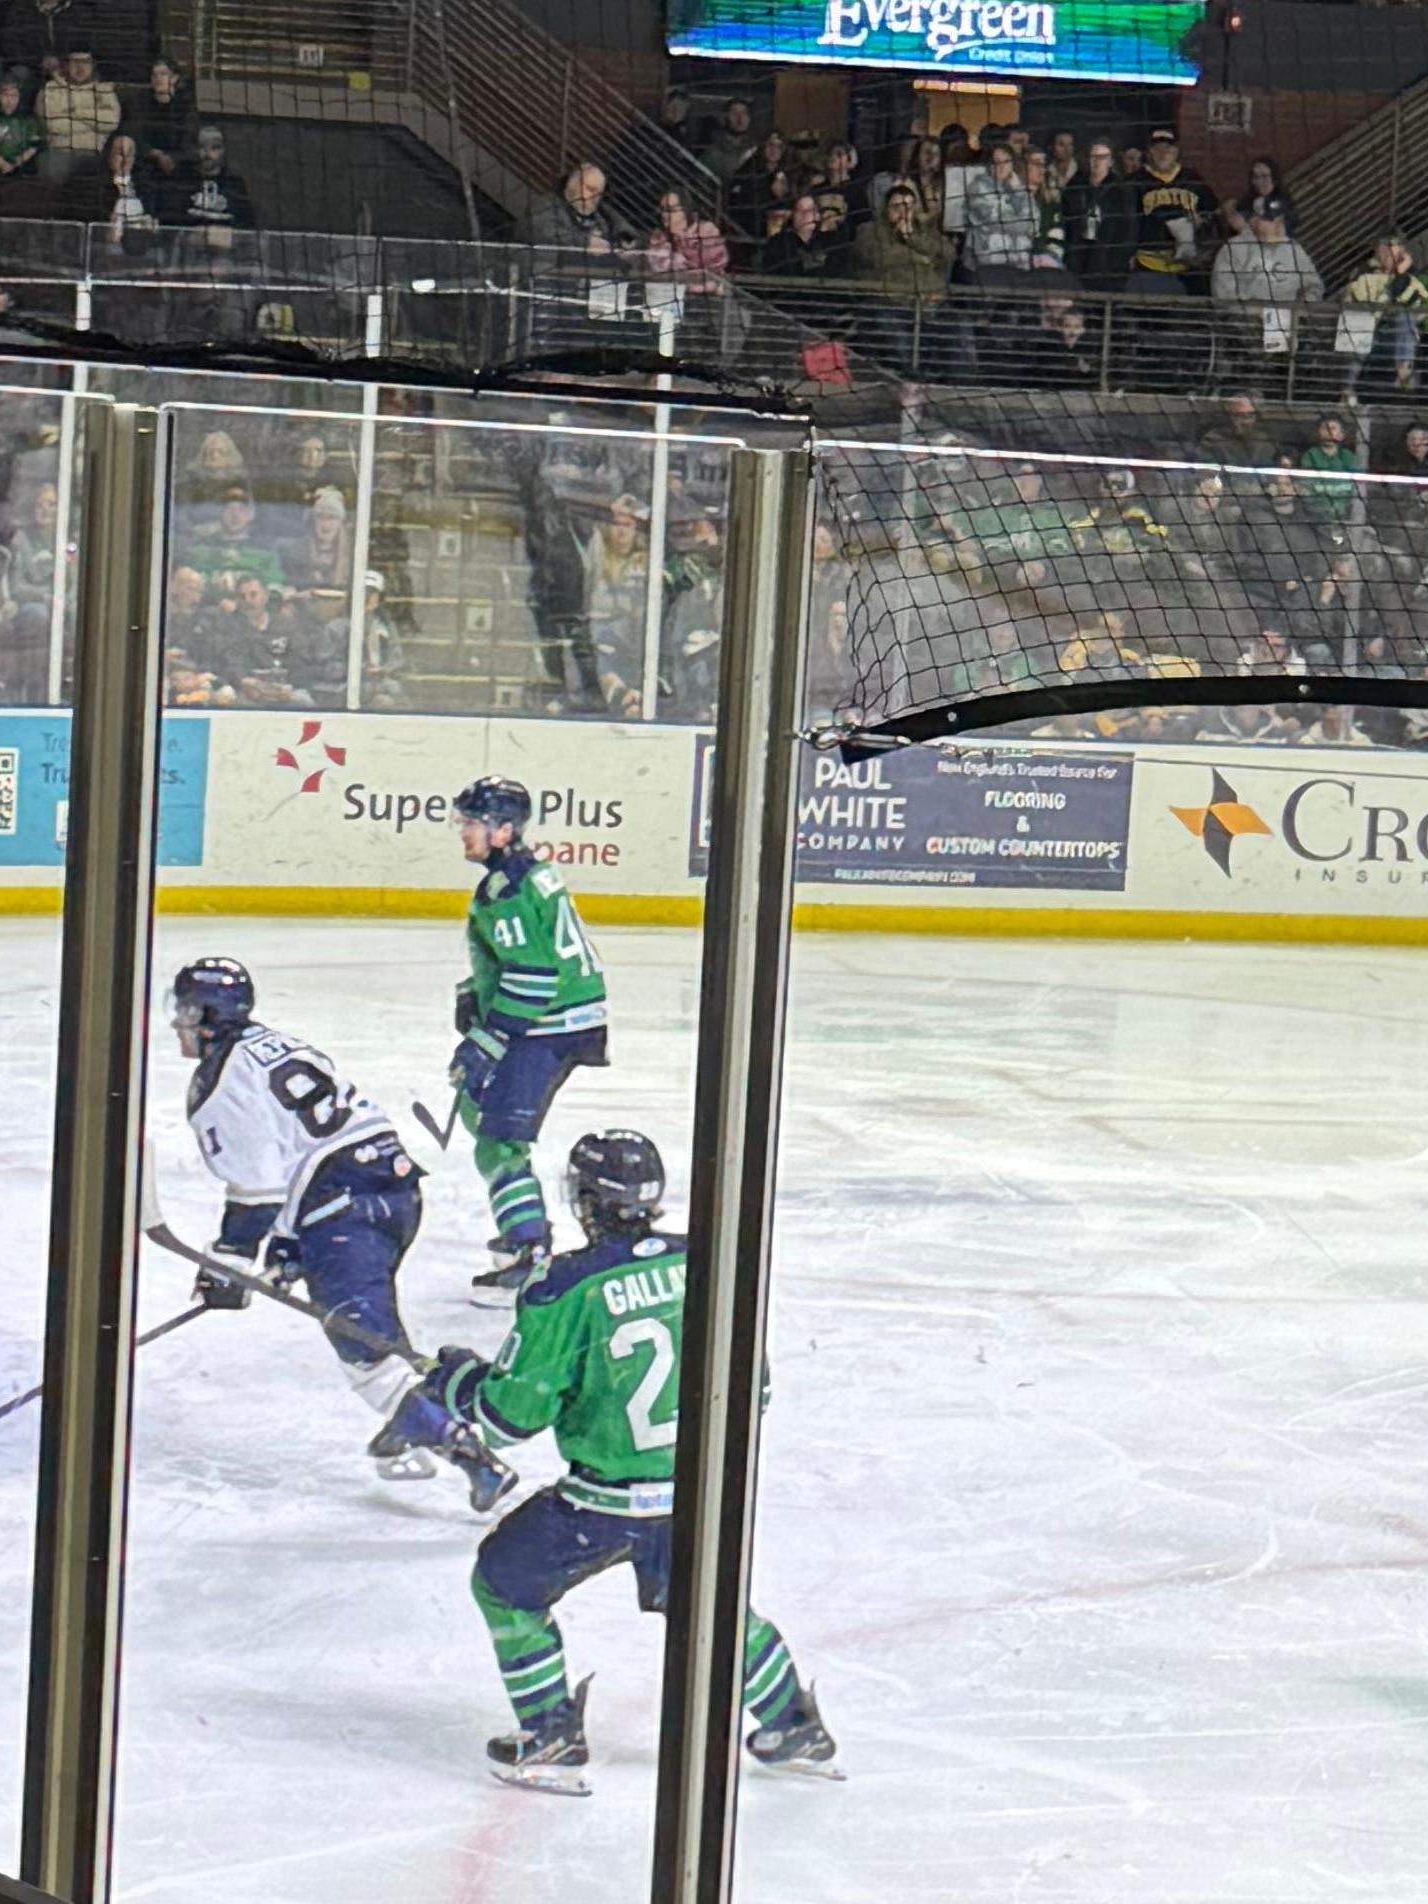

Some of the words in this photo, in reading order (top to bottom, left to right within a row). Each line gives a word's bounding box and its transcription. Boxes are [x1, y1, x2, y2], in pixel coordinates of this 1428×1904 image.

[814, 755, 893, 791] PAUL
[538, 788, 623, 829] Plus
[797, 795, 908, 829] WHITE
[984, 790, 1067, 810] FLOORING
[797, 831, 905, 852] COMPANY
[925, 836, 996, 856] CUSTOM
[997, 837, 1122, 860] COUNTERTOPS
[493, 916, 528, 948] 41
